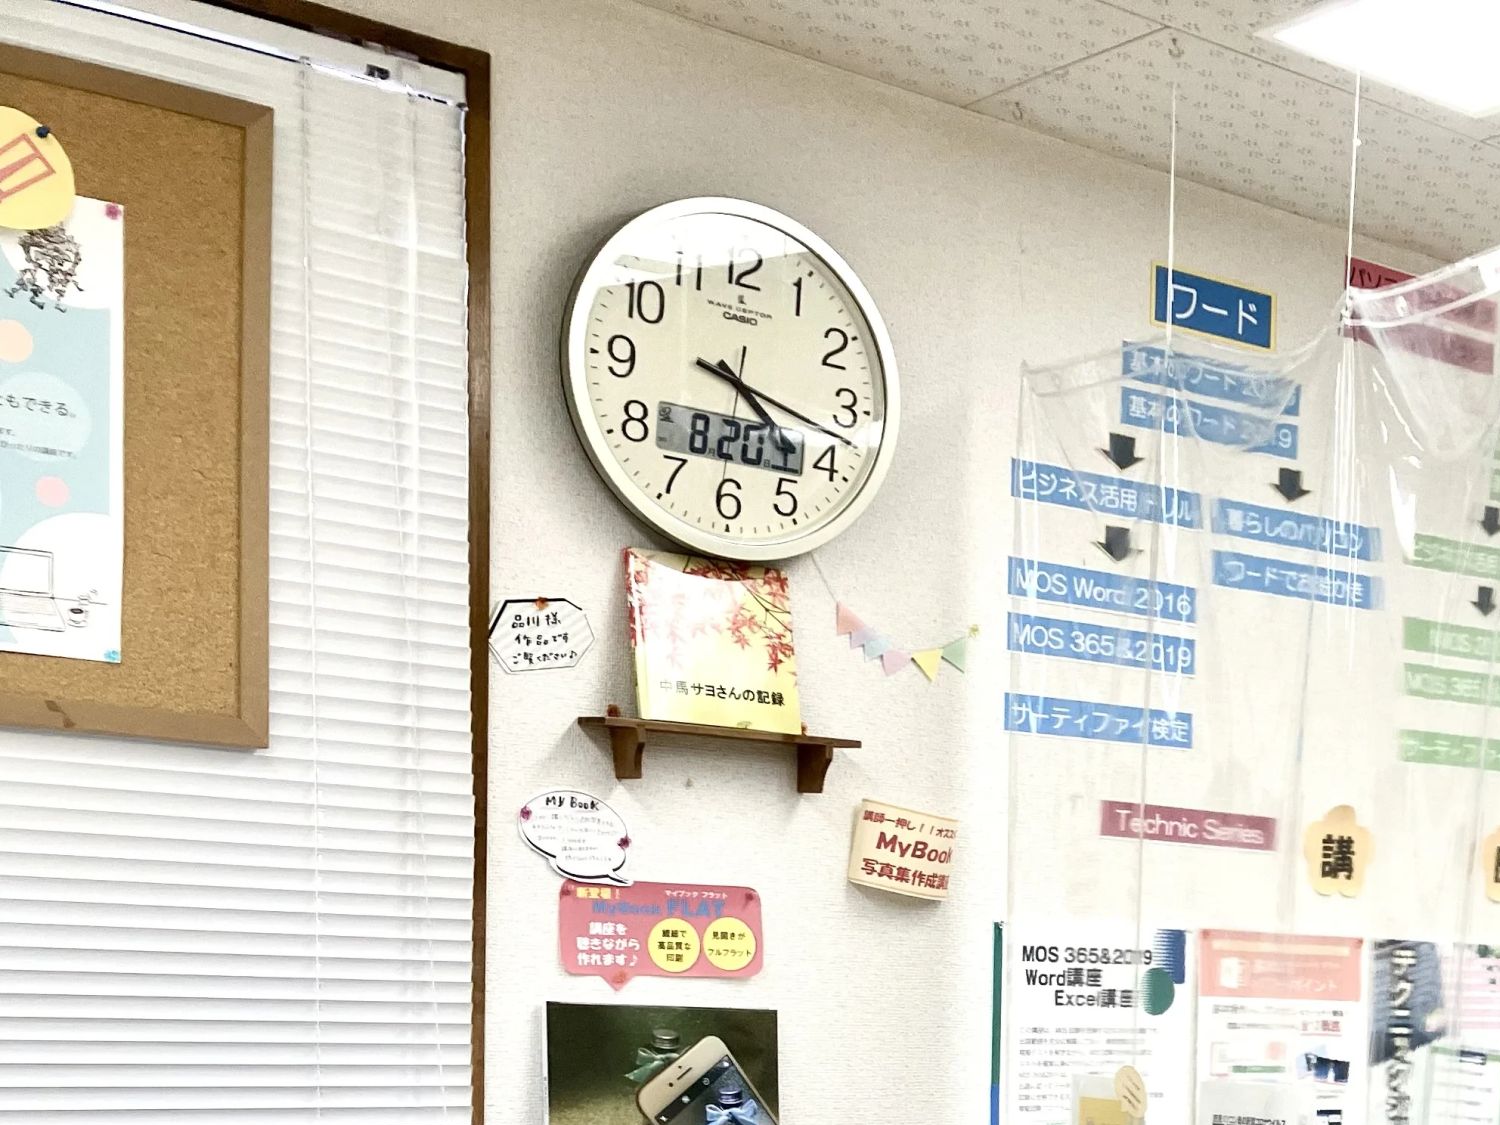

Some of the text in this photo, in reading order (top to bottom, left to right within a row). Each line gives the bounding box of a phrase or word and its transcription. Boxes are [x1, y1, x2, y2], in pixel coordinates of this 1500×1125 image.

[625, 280, 665, 324] 10
[793, 277, 803, 317] 1
[1168, 282, 1258, 335] ワード
[723, 311, 758, 326] CASIO
[607, 335, 637, 378] 9
[822, 327, 849, 370] 2
[621, 400, 649, 442] 8
[833, 388, 858, 428] 3
[663, 456, 688, 495] 7
[813, 445, 838, 482] 4
[715, 479, 741, 520] 6
[773, 478, 798, 517] 5
[660, 680, 786, 706] 中馬サヨさんの記録
[1115, 808, 1198, 840] Technic
[589, 921, 628, 936] 講座を
[1022, 945, 1059, 963] MOS
[1025, 967, 1103, 988] Word講座
